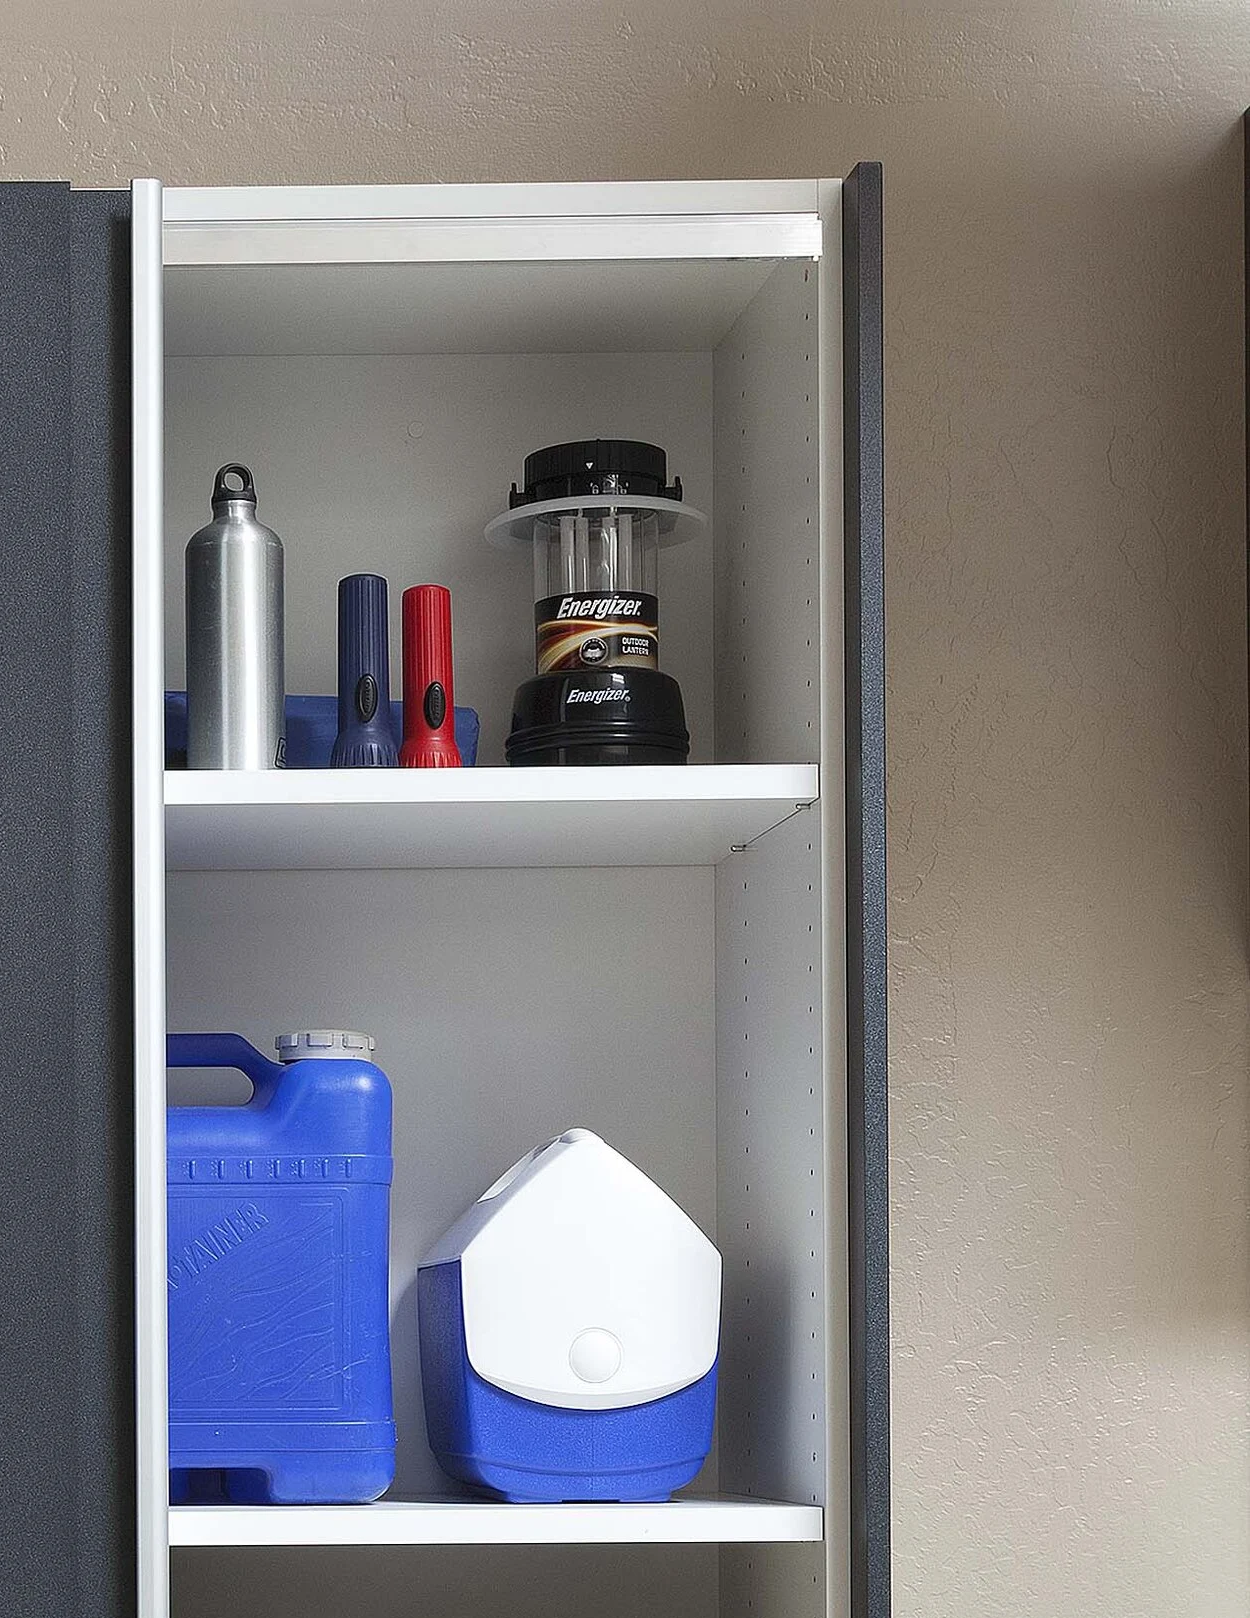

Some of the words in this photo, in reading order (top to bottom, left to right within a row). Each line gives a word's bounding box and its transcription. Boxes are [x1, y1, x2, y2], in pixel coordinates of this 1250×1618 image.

[622, 637, 649, 647] OUTDOOR
[622, 646, 648, 655] LANTERN
[167, 1202, 269, 1289] TAINER
